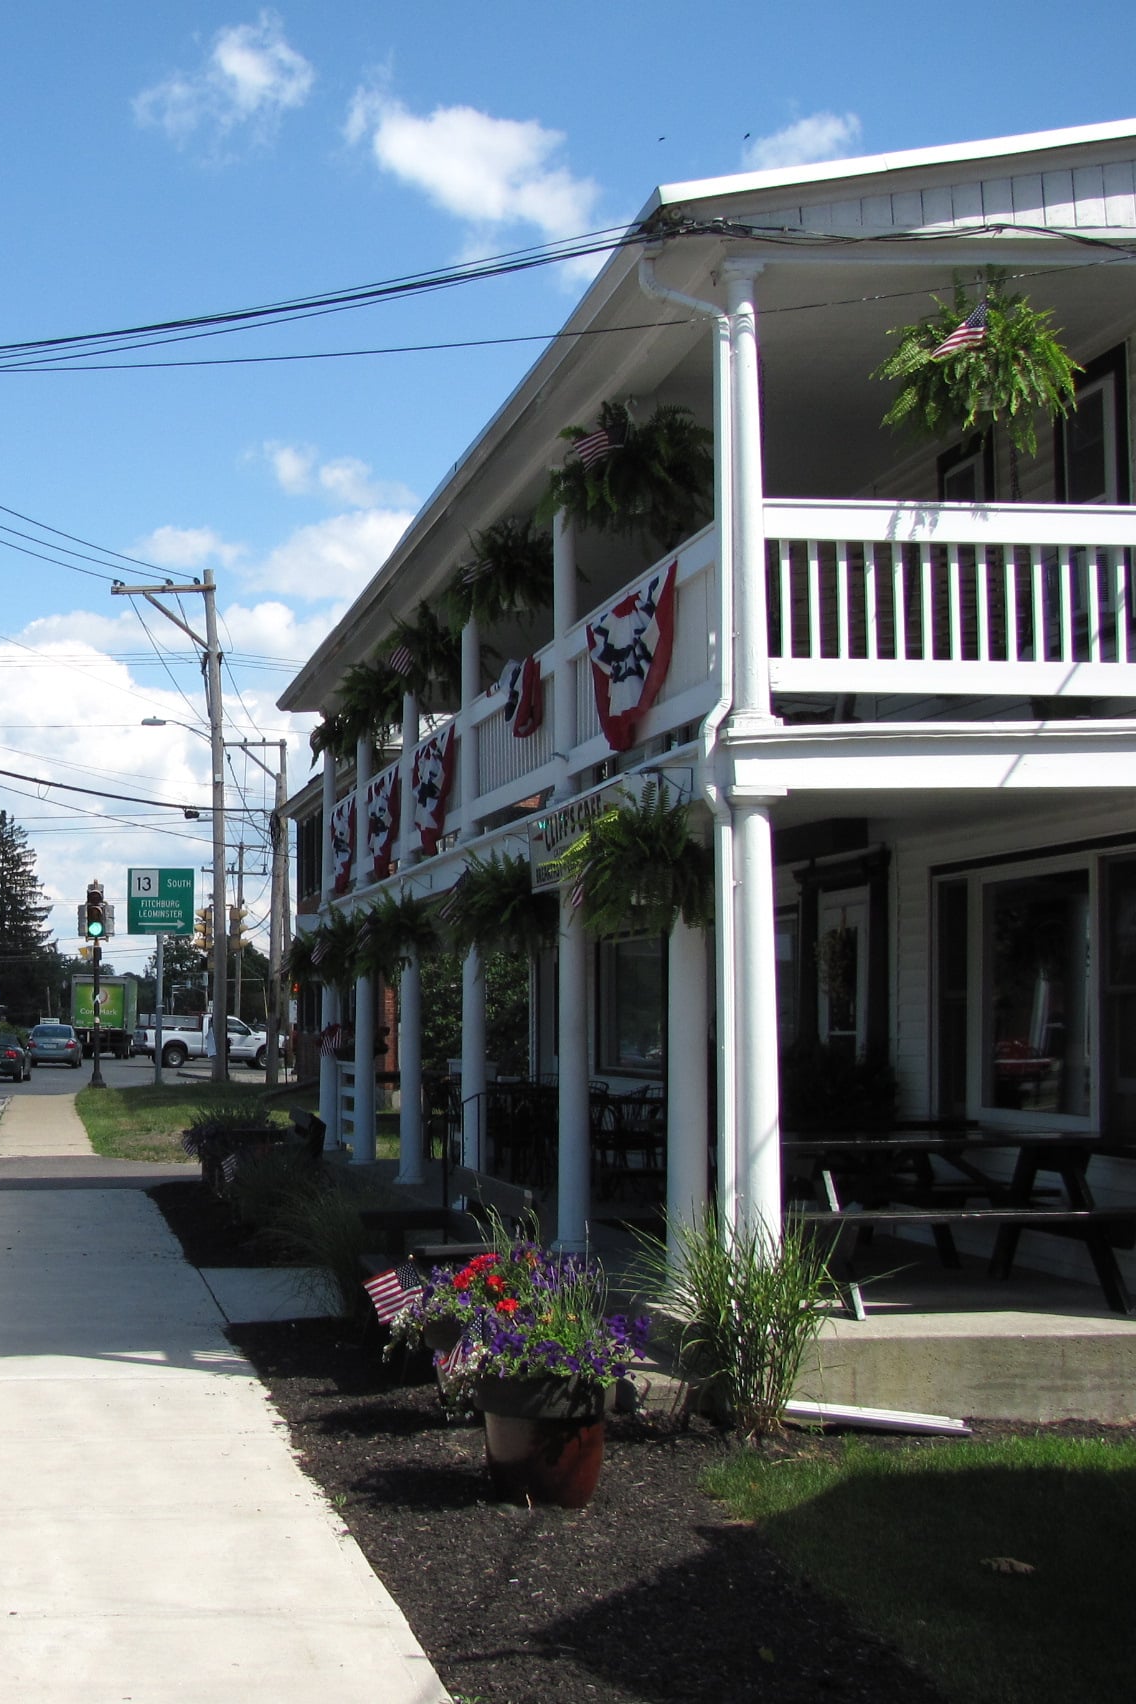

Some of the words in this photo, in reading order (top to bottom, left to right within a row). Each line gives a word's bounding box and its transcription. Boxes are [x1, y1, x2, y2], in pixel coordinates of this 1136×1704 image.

[137, 877, 151, 891] 13
[167, 878, 191, 888] SOUTH
[141, 899, 180, 908] FITCHBURG
[138, 909, 183, 918] LEOMINSTER
